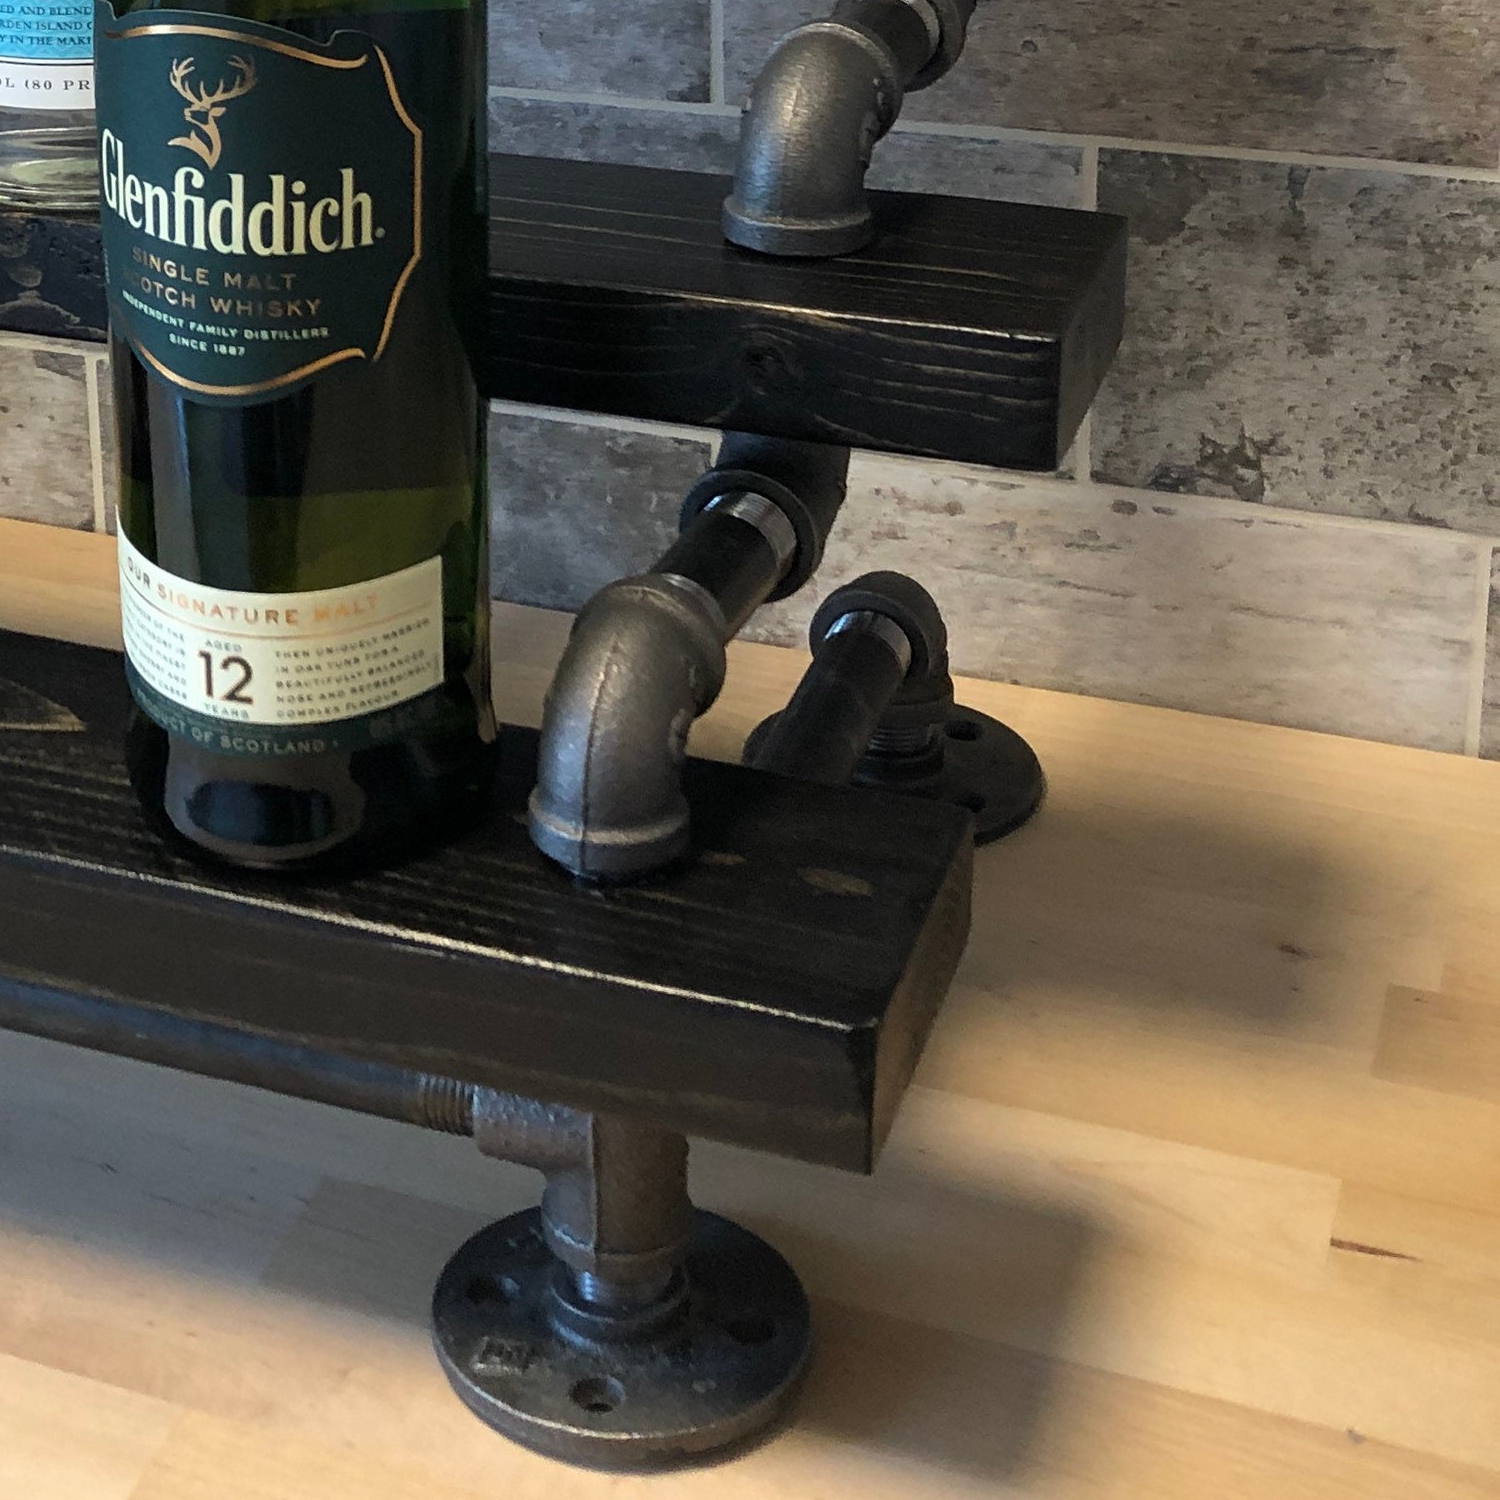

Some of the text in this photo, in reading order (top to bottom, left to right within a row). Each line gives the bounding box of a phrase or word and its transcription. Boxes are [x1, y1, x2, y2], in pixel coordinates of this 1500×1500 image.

[18, 5, 46, 17] AND
[35, 21, 83, 32] ISLAND
[9, 34, 24, 45] IN
[26, 36, 53, 46] THE
[24, 78, 53, 92] (80
[100, 127, 375, 256] Glenfiddich
[132, 245, 211, 287] SINGLE
[223, 270, 298, 293] MALT
[209, 295, 323, 319] WHISKY
[188, 320, 240, 340] FAMILY
[242, 326, 331, 342] DISTILLERS
[168, 332, 247, 357] SINCE 1887
[127, 556, 379, 627] OUR SIGNATURE MALT
[205, 639, 244, 653] AGED
[275, 650, 311, 660] THEN
[197, 649, 255, 707] 12
[204, 702, 251, 720] YEARS
[191, 726, 215, 744] OF
[219, 733, 328, 755] SCOTLAND
